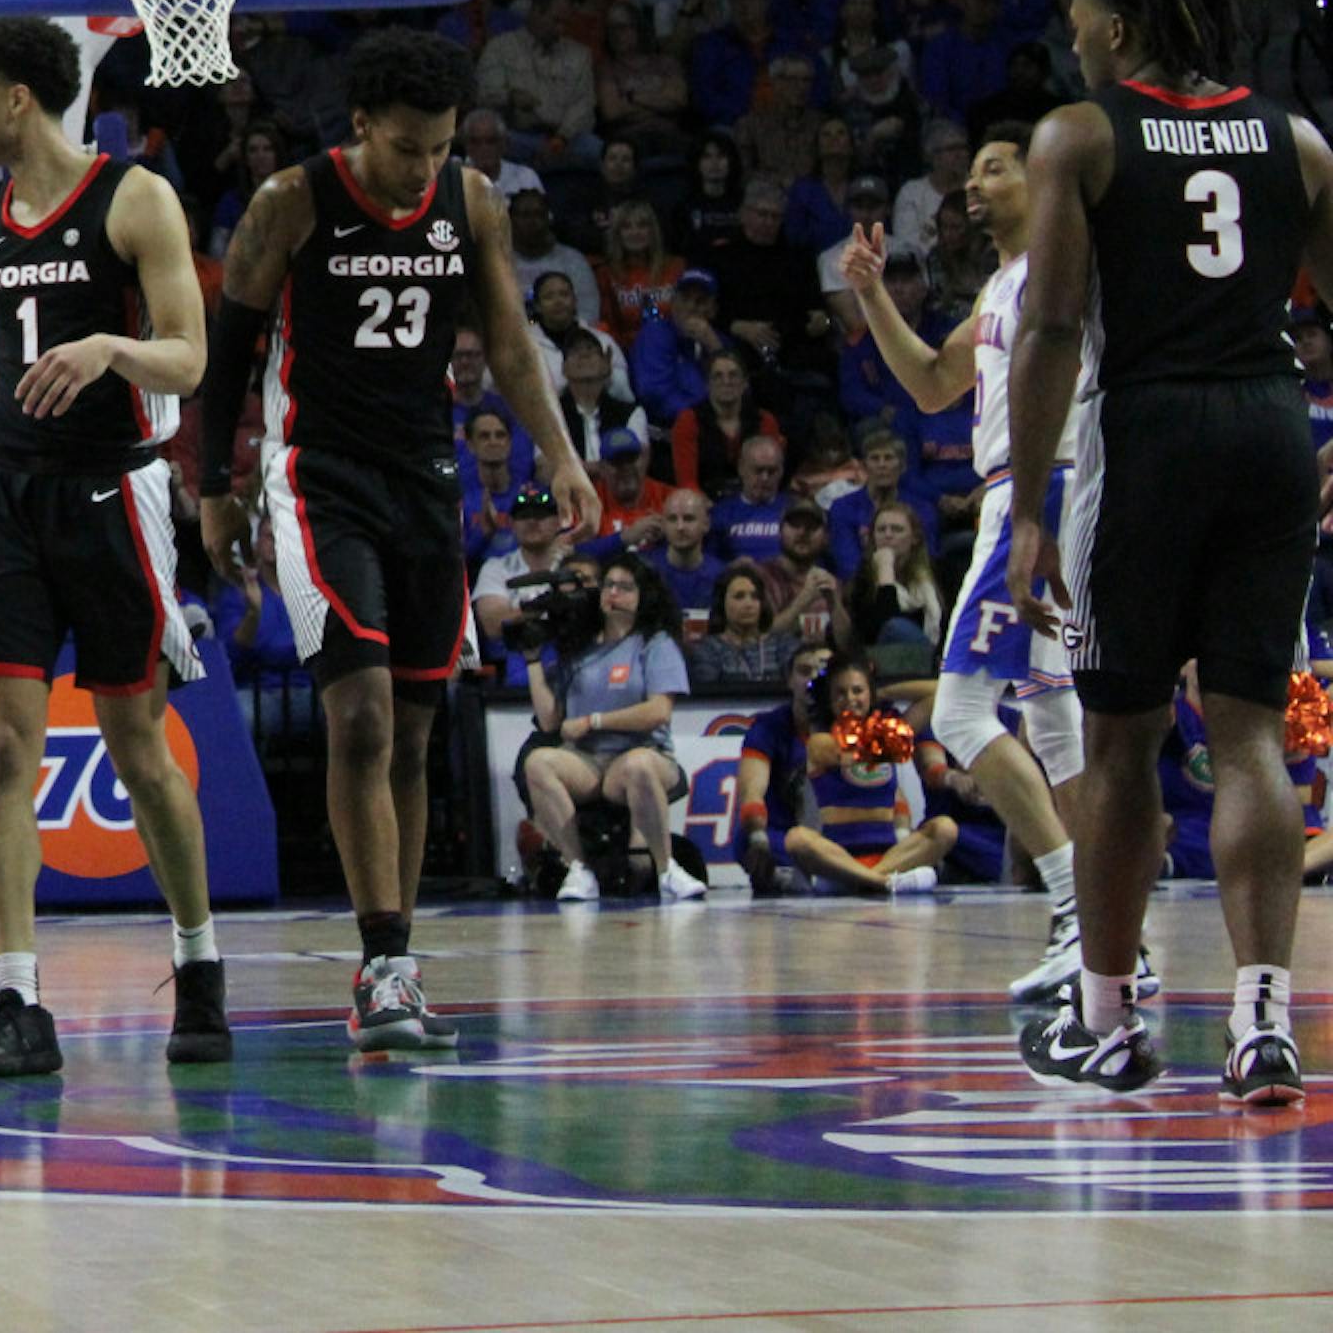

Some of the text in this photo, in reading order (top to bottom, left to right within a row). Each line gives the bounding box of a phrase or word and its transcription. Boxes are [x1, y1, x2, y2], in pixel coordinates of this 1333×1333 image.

[1140, 117, 1270, 155] OQUENDO
[432, 219, 454, 243] SEC
[1183, 169, 1245, 280] 3
[328, 252, 466, 278] GEORGIA
[15, 295, 39, 365] 1
[353, 285, 432, 350] 23
[729, 522, 782, 537] FLORID
[968, 598, 1020, 656] F
